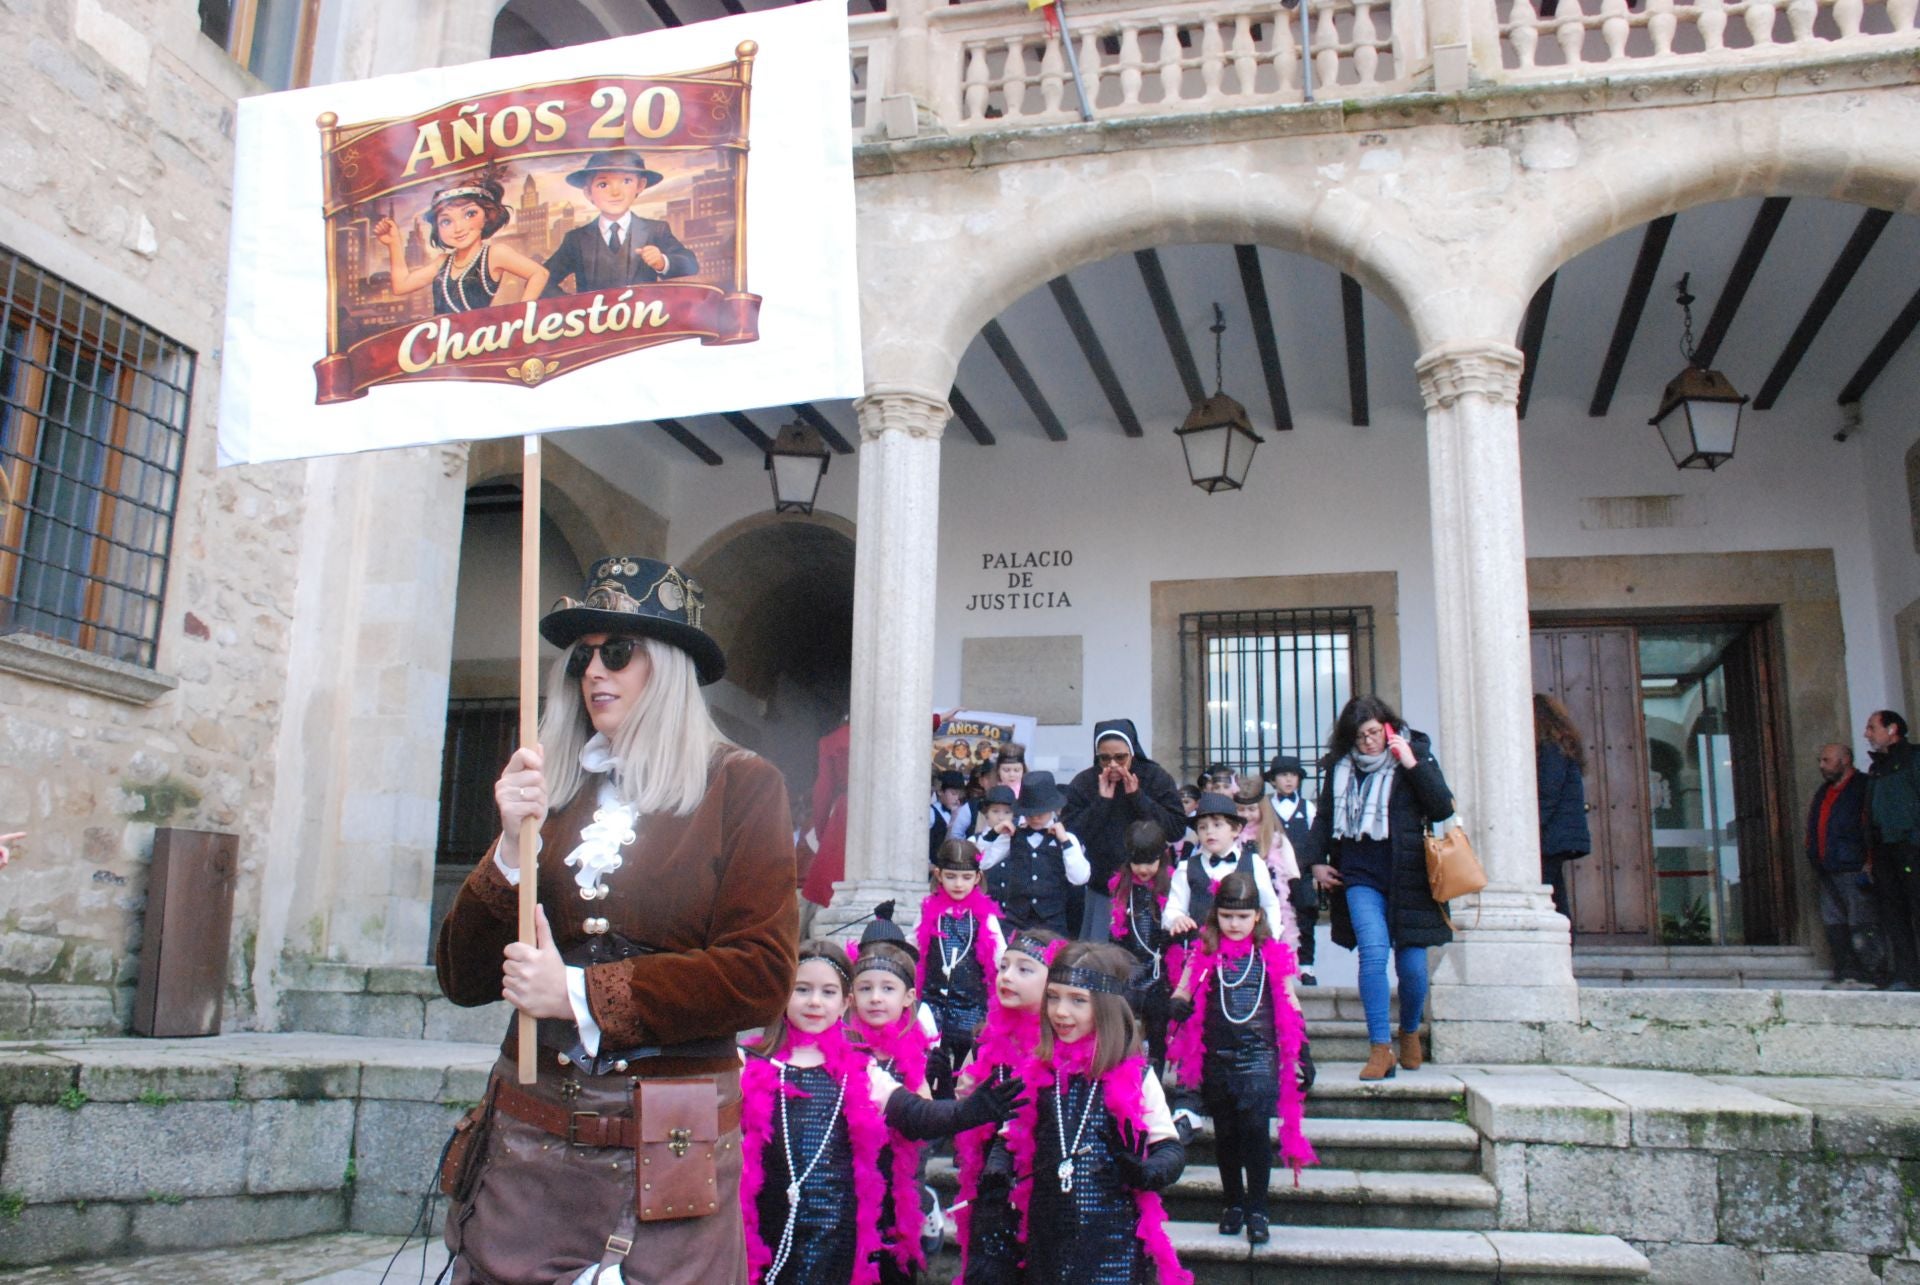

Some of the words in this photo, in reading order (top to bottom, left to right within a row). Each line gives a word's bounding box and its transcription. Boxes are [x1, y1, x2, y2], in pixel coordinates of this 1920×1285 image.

[401, 99, 567, 177] AÑOS
[587, 86, 683, 140] 20
[398, 290, 670, 373] Charlestón
[982, 550, 1073, 569] PALACIO
[1008, 572, 1033, 588] DE
[966, 592, 1072, 610] JUSTICIA
[981, 725, 1000, 739] 40
